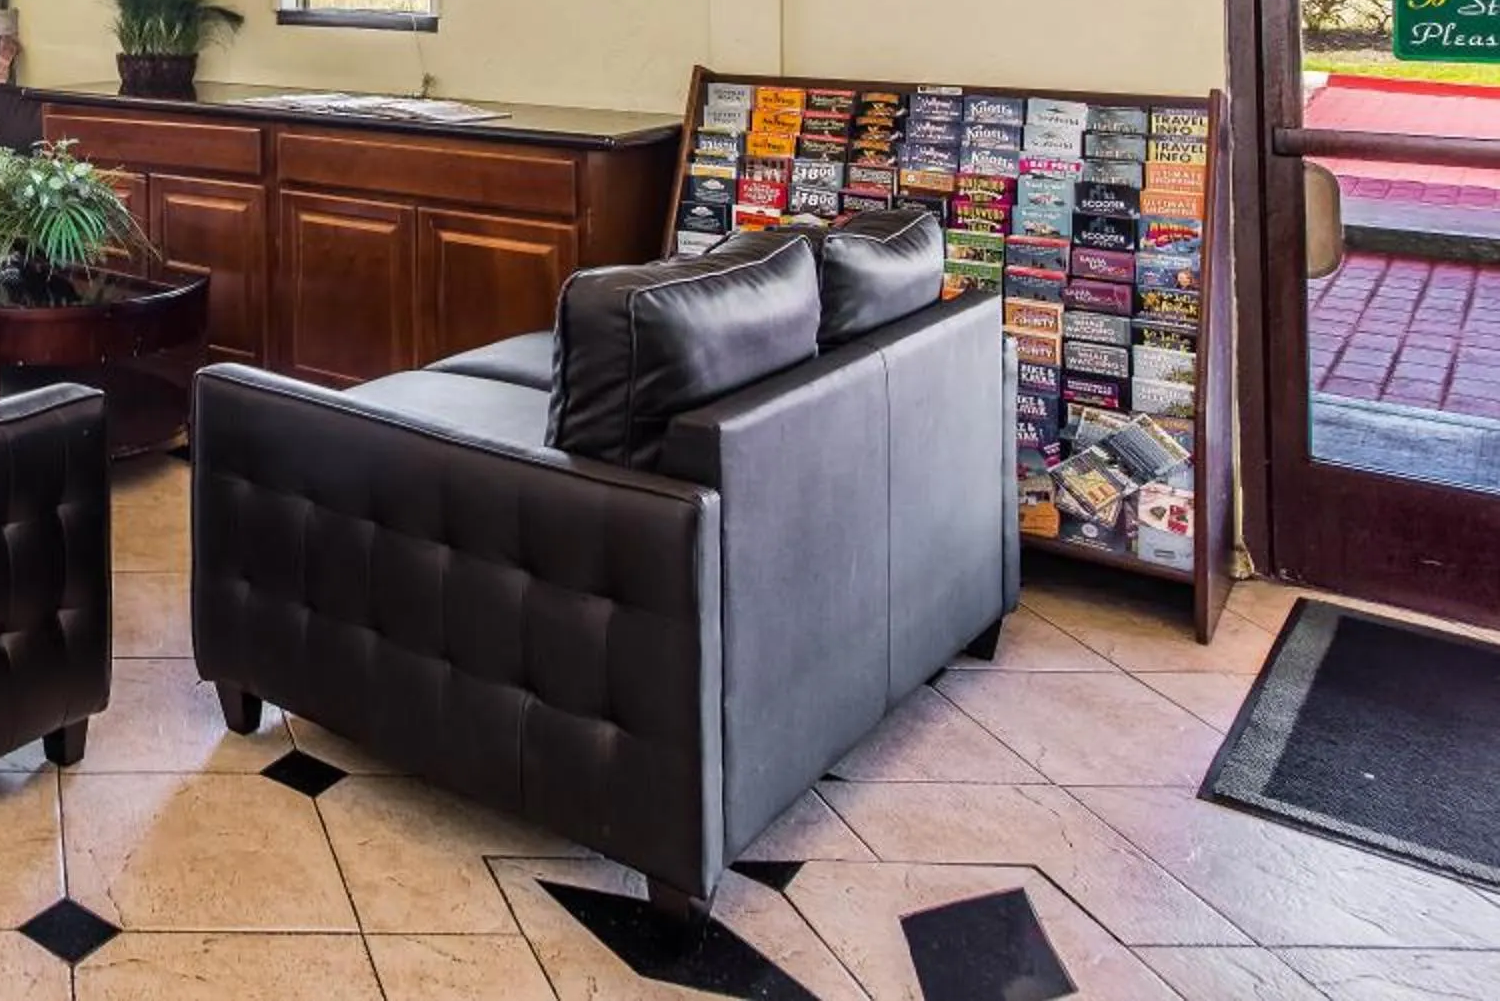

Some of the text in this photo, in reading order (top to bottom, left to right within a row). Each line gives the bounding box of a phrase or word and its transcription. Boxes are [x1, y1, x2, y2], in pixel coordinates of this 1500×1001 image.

[1155, 114, 1206, 126] TRAVEL
[1155, 124, 1192, 135] INFO
[1155, 142, 1206, 153] TRAVEL
[1155, 152, 1192, 163] INFO
[1081, 200, 1125, 210] SCOOTER
[1080, 231, 1125, 243] SCOOTER
